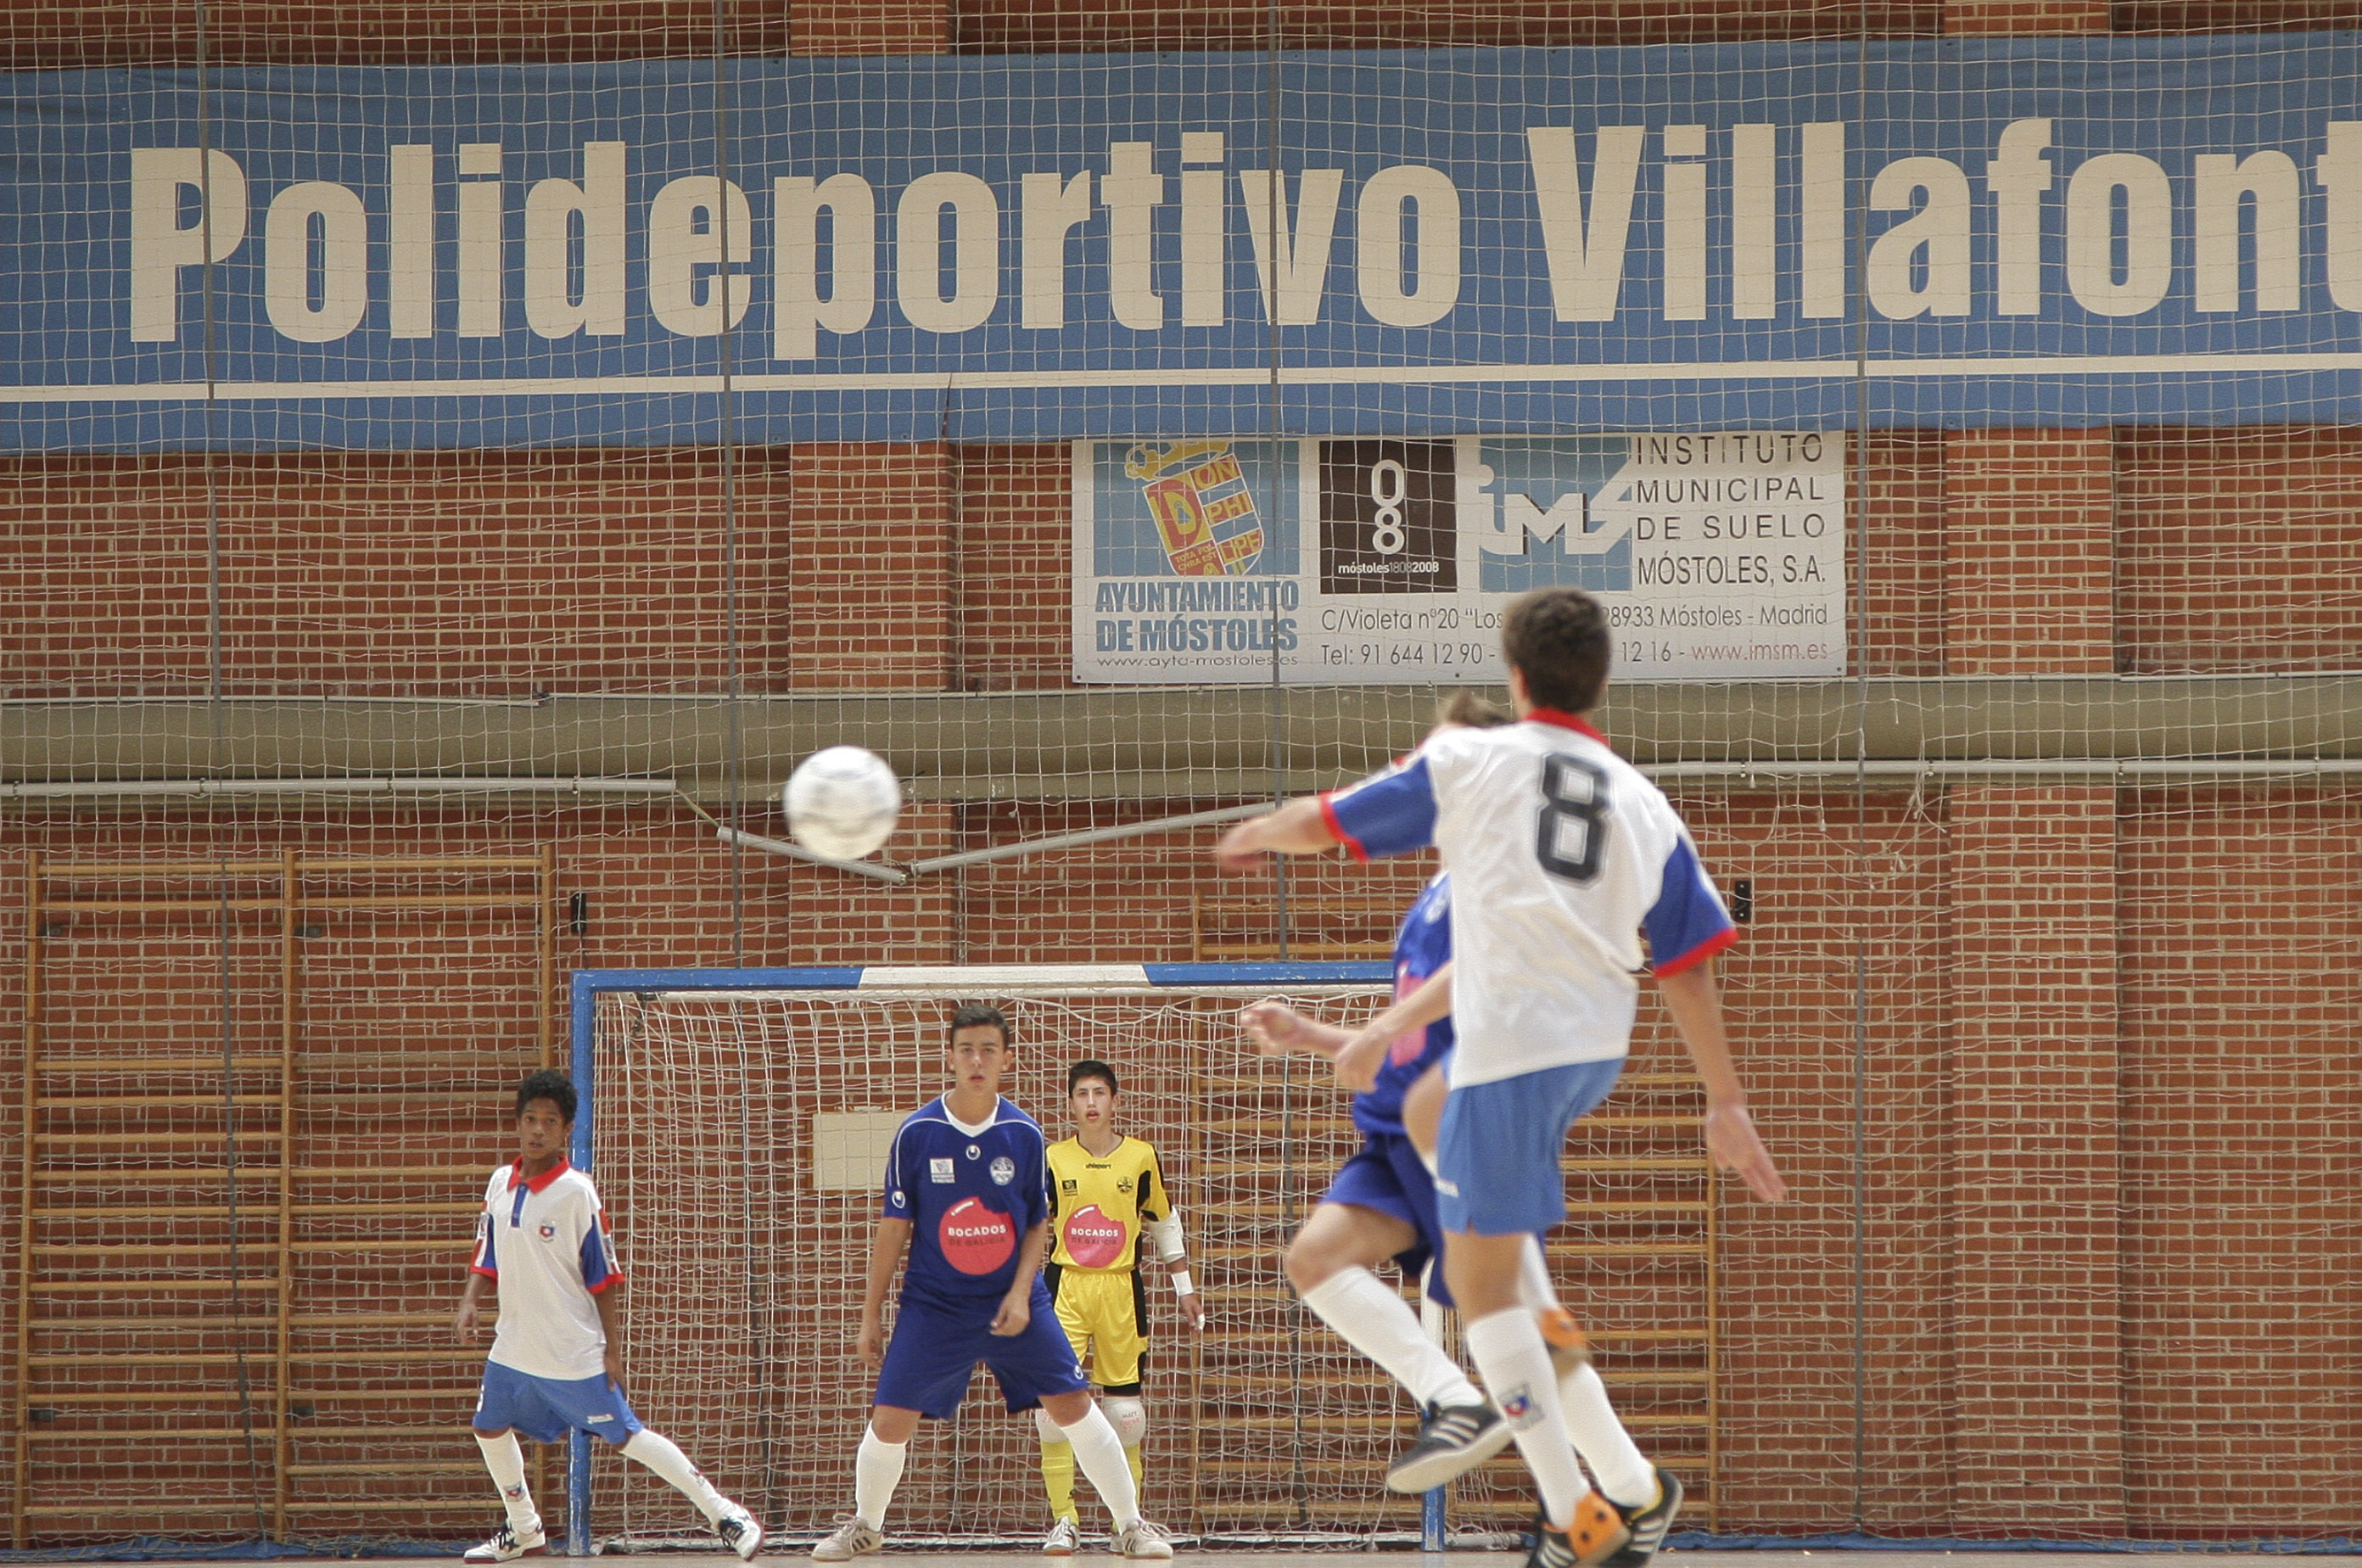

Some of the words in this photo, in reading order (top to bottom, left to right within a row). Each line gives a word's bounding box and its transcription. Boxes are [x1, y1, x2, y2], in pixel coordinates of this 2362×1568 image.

[130, 131, 1461, 361] Polideportivo
[1527, 118, 2362, 322] Villafont
[1637, 434, 1822, 465] INSTITUTO
[1637, 477, 1824, 503] MUNICIPAL
[1637, 516, 1681, 540] DE
[1703, 513, 1825, 539] SUELO
[1638, 550, 1774, 587] MÓSTOLES,
[1783, 554, 1825, 584] S.A.
[1095, 580, 1299, 613] AYUNTAMIENTO
[1321, 608, 1412, 633] C/Violeta
[1660, 604, 1742, 626] Móstoles
[1760, 602, 1827, 625] Madrid
[1096, 620, 1133, 652] DE
[1139, 613, 1298, 652] MÓSTOLES
[1321, 644, 1353, 665] Tel:
[1361, 644, 1380, 664] 91
[1391, 645, 1424, 664] 644
[1434, 643, 1452, 664] 12
[1460, 643, 1482, 664] 90
[1622, 641, 1642, 662] 12
[1652, 641, 1671, 661] 16
[1691, 641, 1827, 660] www.imsm.es
[1536, 753, 1609, 882] 8
[948, 1224, 1007, 1237] BOCADOS
[1071, 1227, 1119, 1237] BOCADOS
